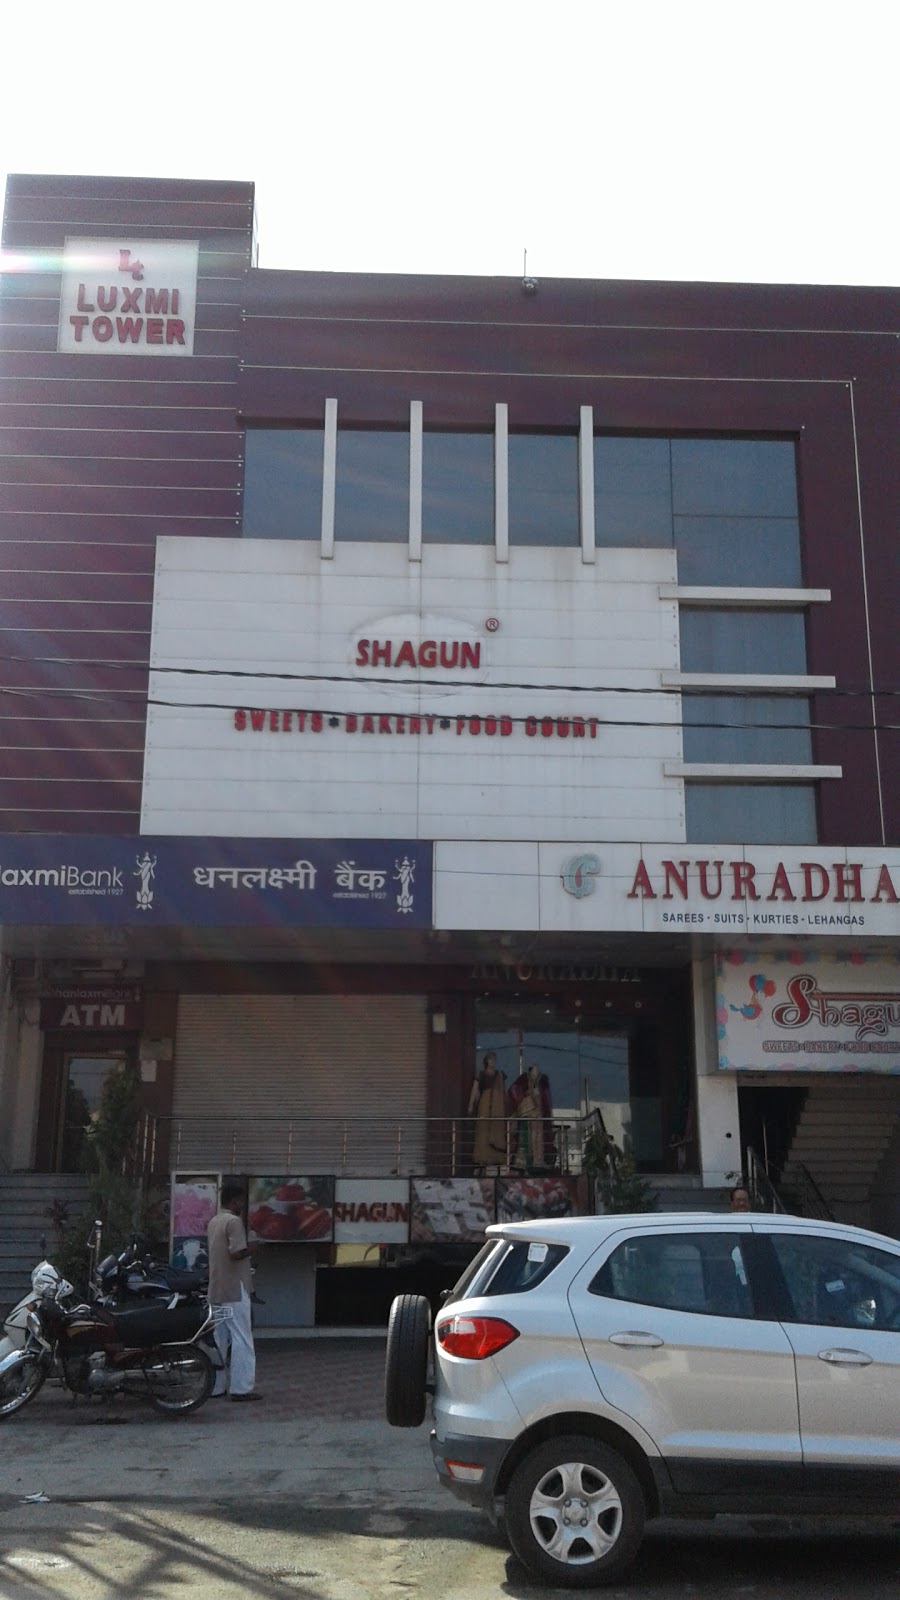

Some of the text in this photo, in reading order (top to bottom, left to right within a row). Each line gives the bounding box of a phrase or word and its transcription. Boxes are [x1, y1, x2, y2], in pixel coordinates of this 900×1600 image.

[77, 283, 179, 315] LUXMI
[69, 315, 185, 345] TOWER
[355, 638, 481, 669] SHAGUN
[234, 708, 323, 733] SWEETS
[456, 714, 512, 737] FOOD
[525, 715, 598, 738] COURT
[193, 860, 387, 891] धनलक्ष्मी बैंक
[626, 858, 900, 903] ANURADHA
[662, 913, 865, 926] SAREES SUITS KURTIES LEHANGAS
[59, 1004, 126, 1027] ATM
